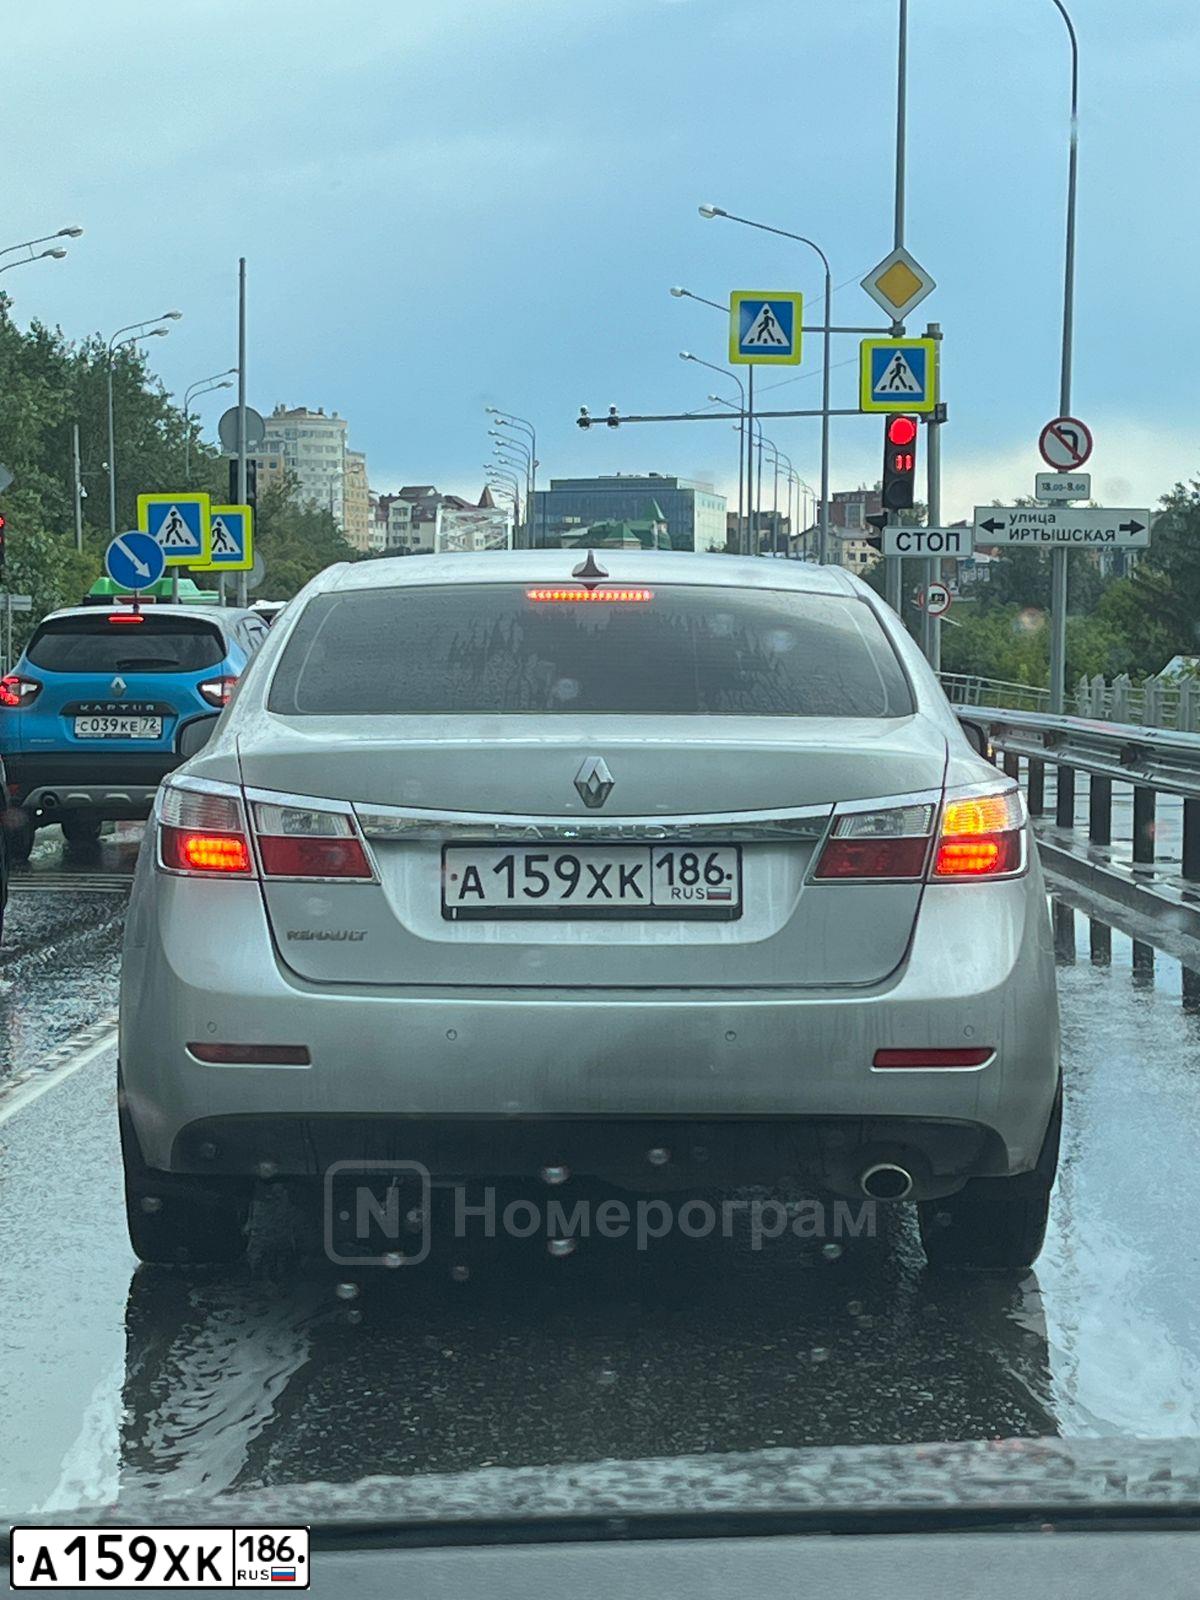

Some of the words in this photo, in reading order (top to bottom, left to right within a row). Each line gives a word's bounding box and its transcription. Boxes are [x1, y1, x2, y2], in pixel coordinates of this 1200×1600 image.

[1009, 513, 1056, 527] улица
[896, 532, 961, 552] СТОП
[1009, 527, 1116, 542] ИРТЫШСКАЯ
[656, 853, 725, 886] 186
[671, 887, 705, 900] RUS
